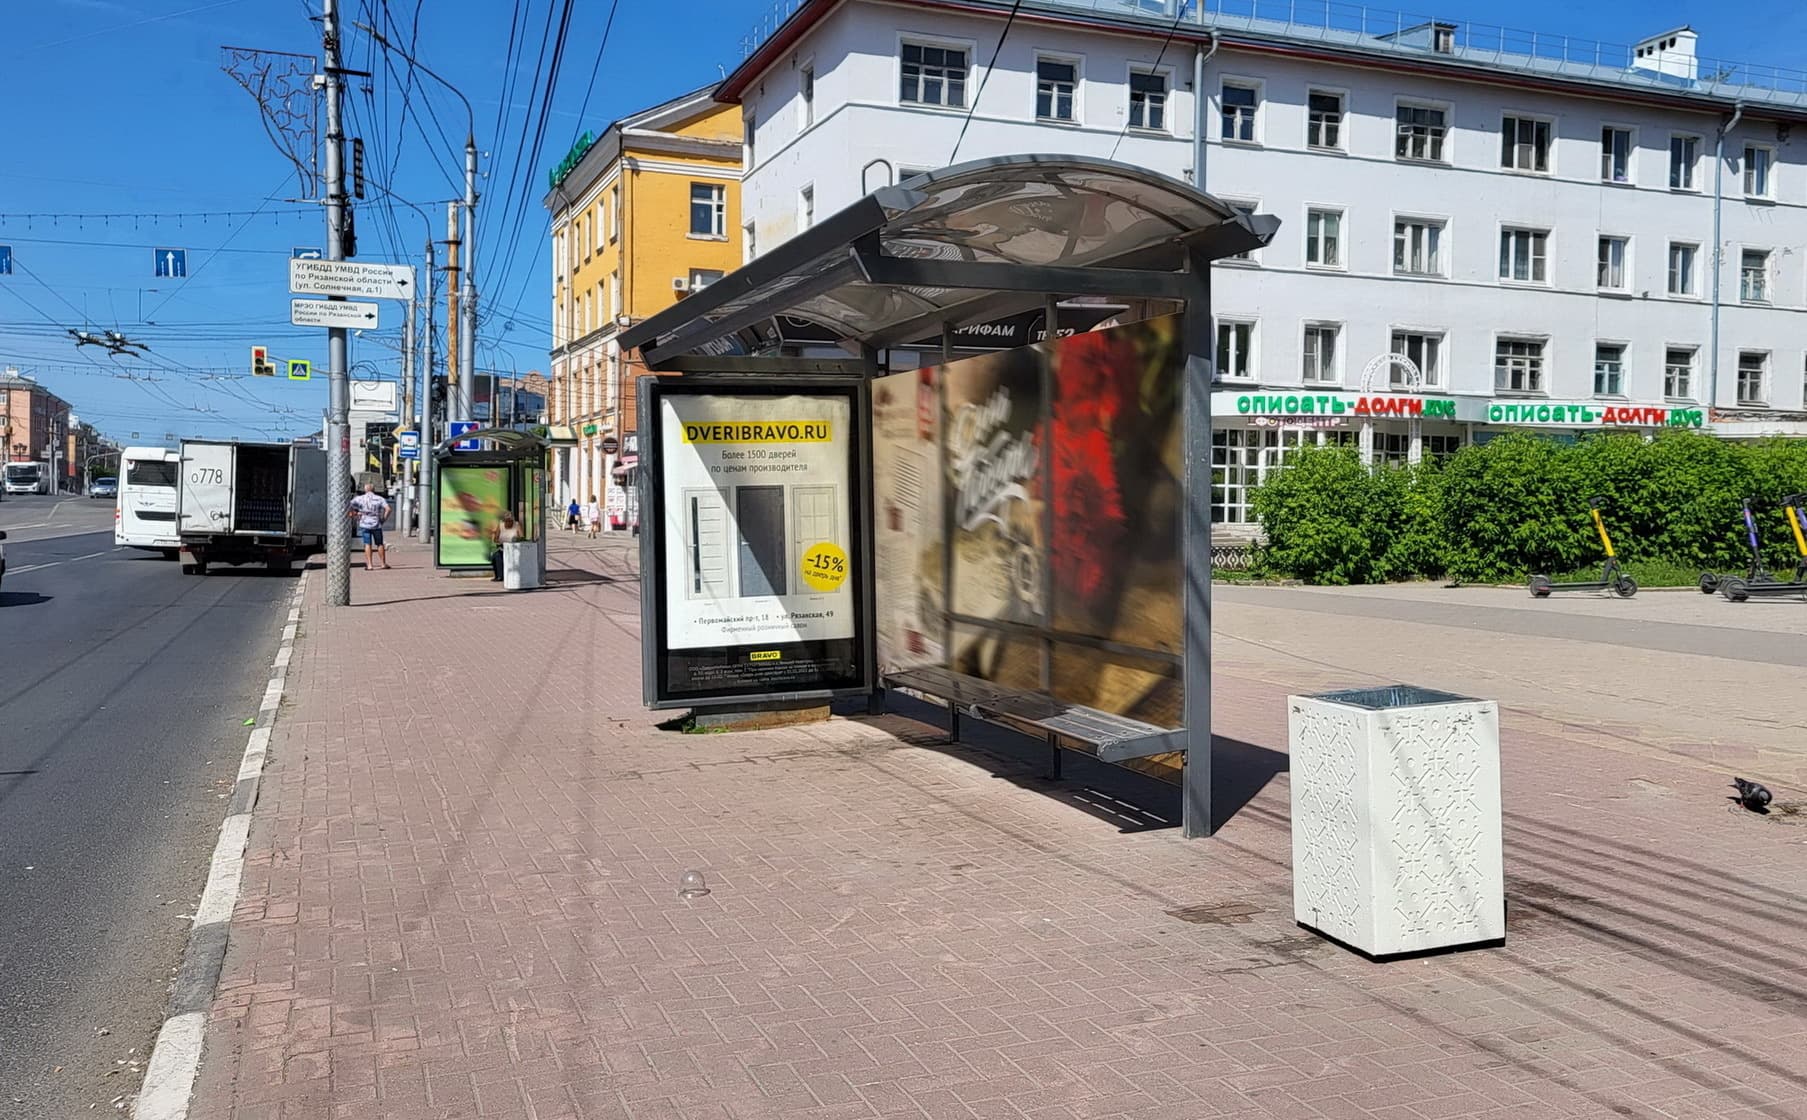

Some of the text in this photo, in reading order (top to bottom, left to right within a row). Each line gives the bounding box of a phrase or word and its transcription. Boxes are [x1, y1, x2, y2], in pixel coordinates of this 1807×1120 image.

[296, 263, 393, 276] УГИБДД УМВД России
[308, 273, 354, 282] Рязанской
[356, 277, 392, 285] области
[295, 281, 311, 290] (ул.
[313, 282, 364, 292] Солнечная,
[687, 425, 827, 441] DVERIBRAVO.RU
[722, 449, 797, 460] Более 1500 дверей
[711, 463, 808, 474] по ценам производителя
[807, 553, 844, 573] -15%
[699, 616, 744, 626] Первомайский
